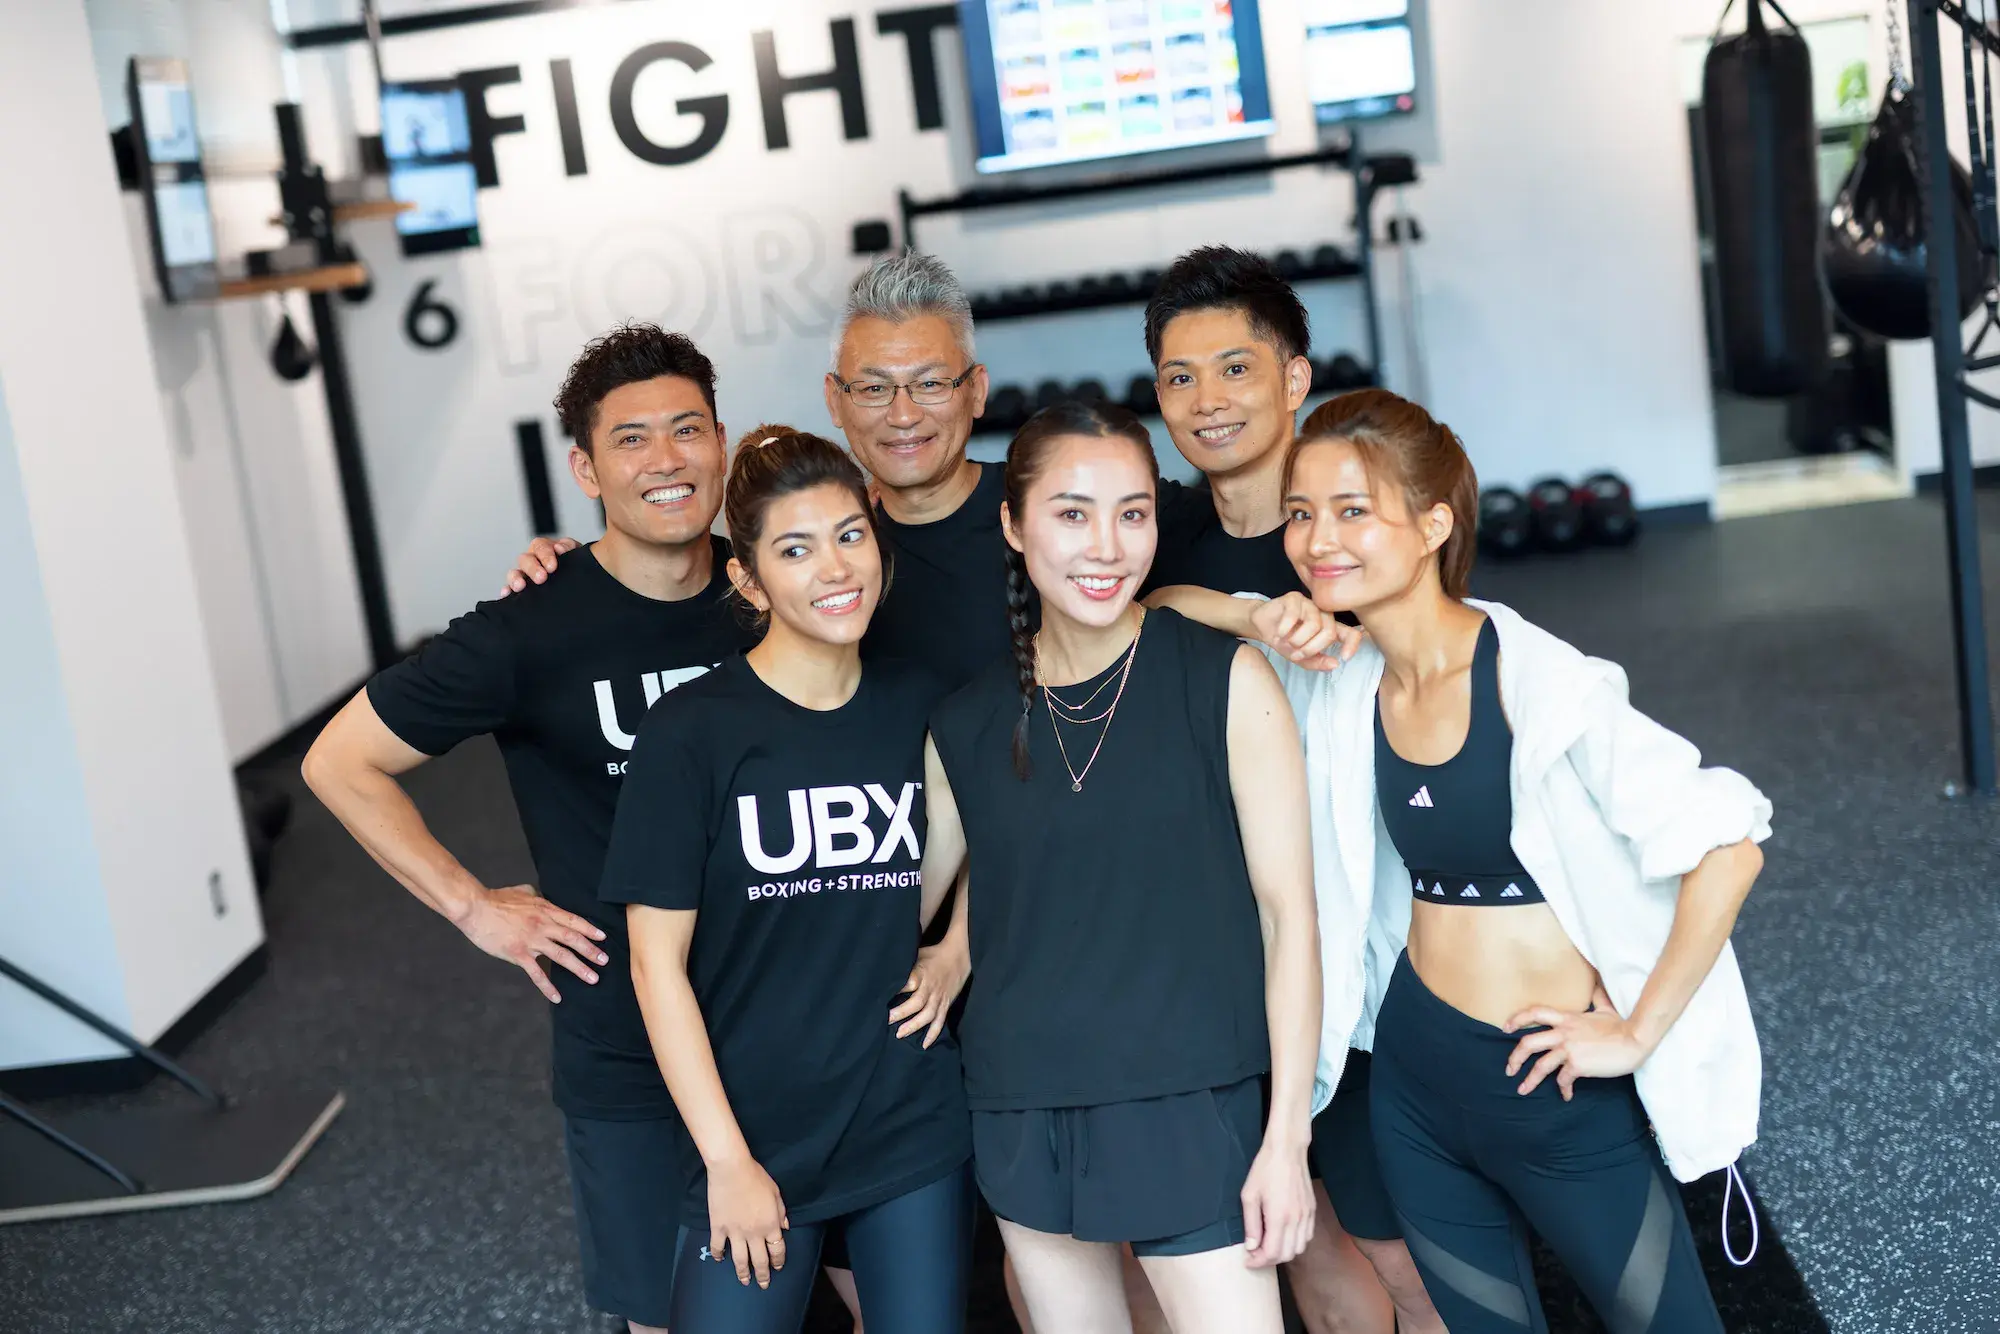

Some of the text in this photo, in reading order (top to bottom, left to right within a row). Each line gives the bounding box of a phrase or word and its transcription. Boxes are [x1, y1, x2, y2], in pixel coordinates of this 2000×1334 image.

[456, 4, 960, 188] FIGHT
[402, 276, 459, 350] 6
[486, 204, 840, 378] FOR
[737, 782, 921, 874] UBX
